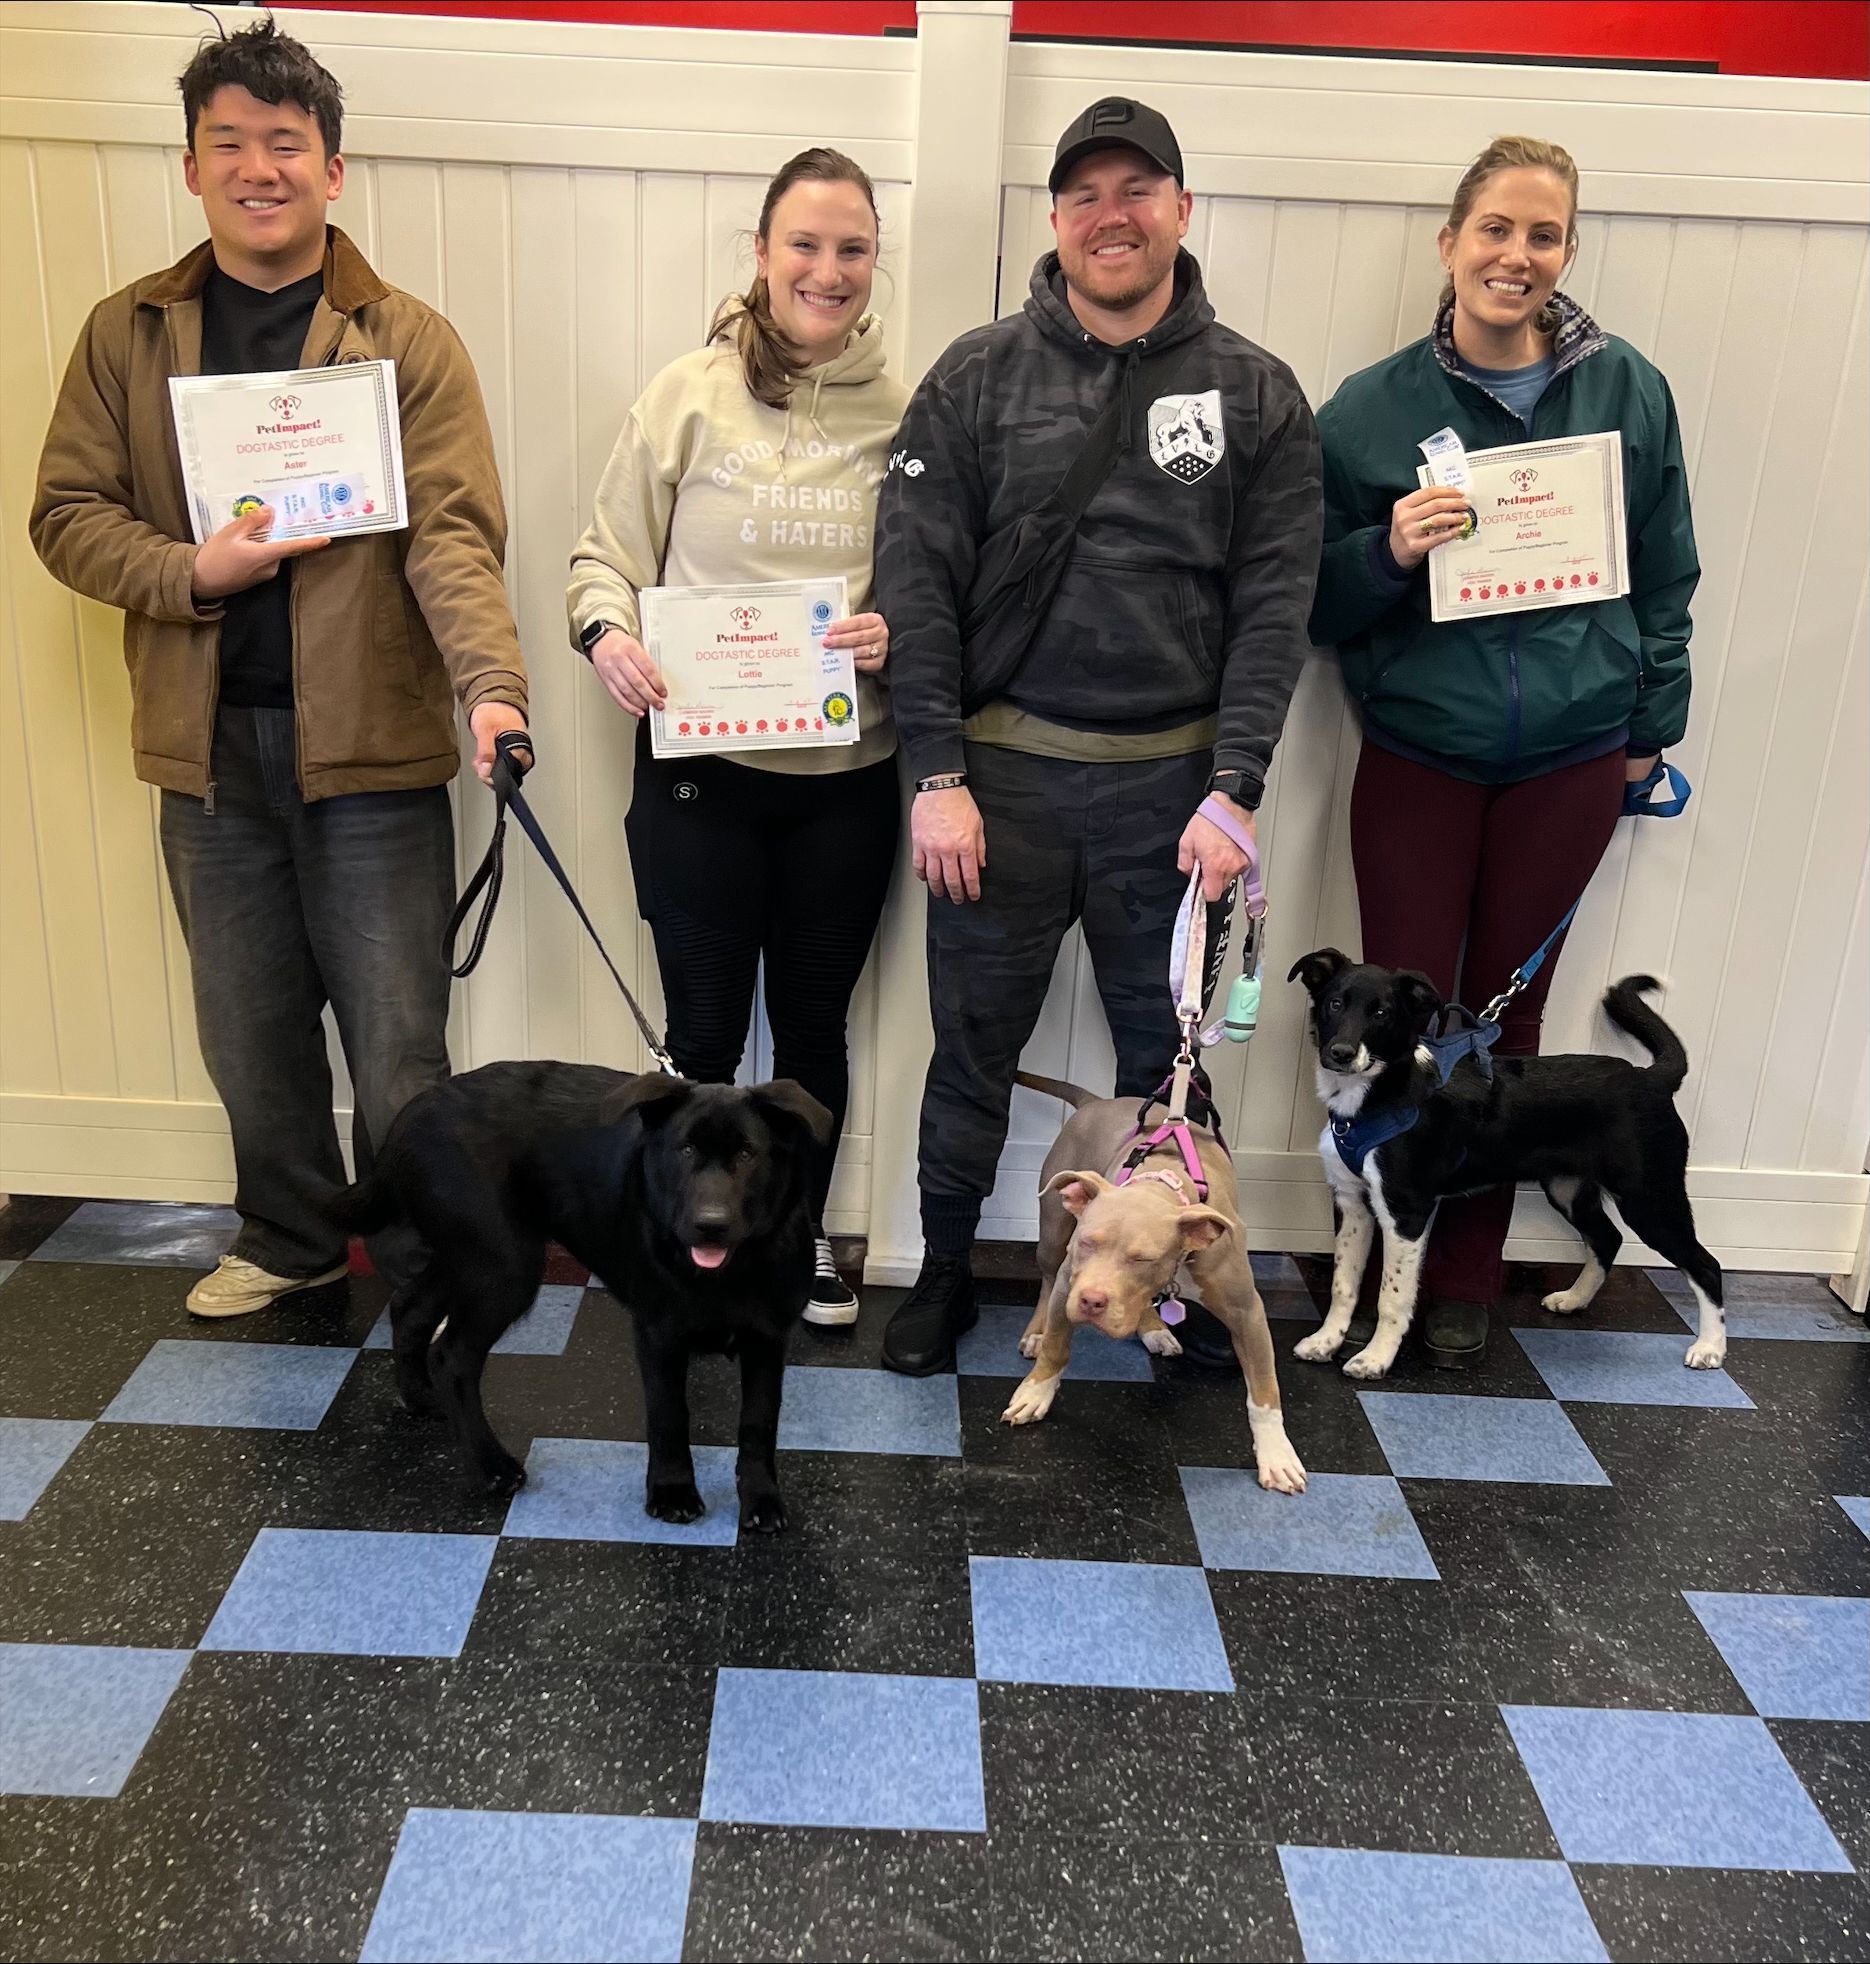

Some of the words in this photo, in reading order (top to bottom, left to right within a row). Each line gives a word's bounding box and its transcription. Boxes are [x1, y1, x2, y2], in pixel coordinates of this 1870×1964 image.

[256, 419, 321, 434] PetImpact!
[236, 440, 299, 454] DOGTASTIC
[301, 433, 345, 448] DEGREE
[284, 460, 307, 470] Aster
[712, 440, 774, 488] GOOD
[752, 484, 863, 512] FRIENDS
[1497, 491, 1554, 506] PetImpact!
[1535, 505, 1575, 519] DEGREE
[739, 518, 758, 543] &
[771, 520, 867, 547] HATERS
[1515, 530, 1542, 540] Archie
[716, 632, 778, 644] PetImpact!
[695, 649, 755, 661] DOGTASTIC
[757, 647, 800, 659] DEGREE
[738, 670, 763, 679] Lottie
[679, 786, 691, 799] S
